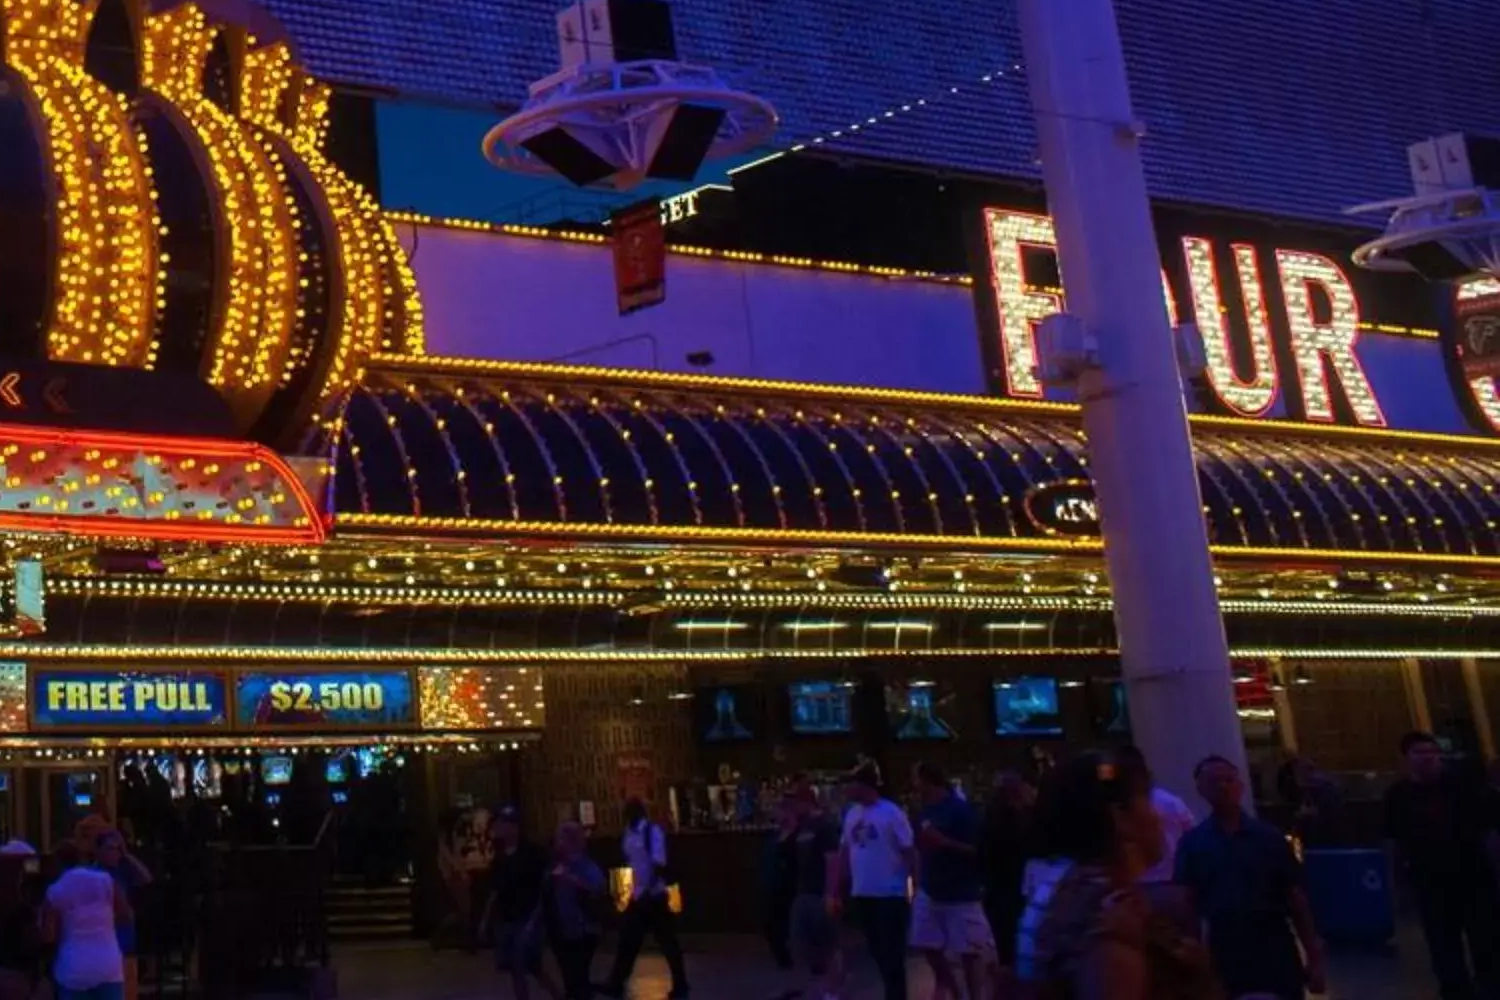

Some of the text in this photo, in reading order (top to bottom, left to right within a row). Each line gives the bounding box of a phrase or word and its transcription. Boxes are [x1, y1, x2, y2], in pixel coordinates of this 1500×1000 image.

[983, 206, 1388, 428] FUR
[47, 681, 212, 711] FREE PULL
[269, 681, 384, 712] $2,500
